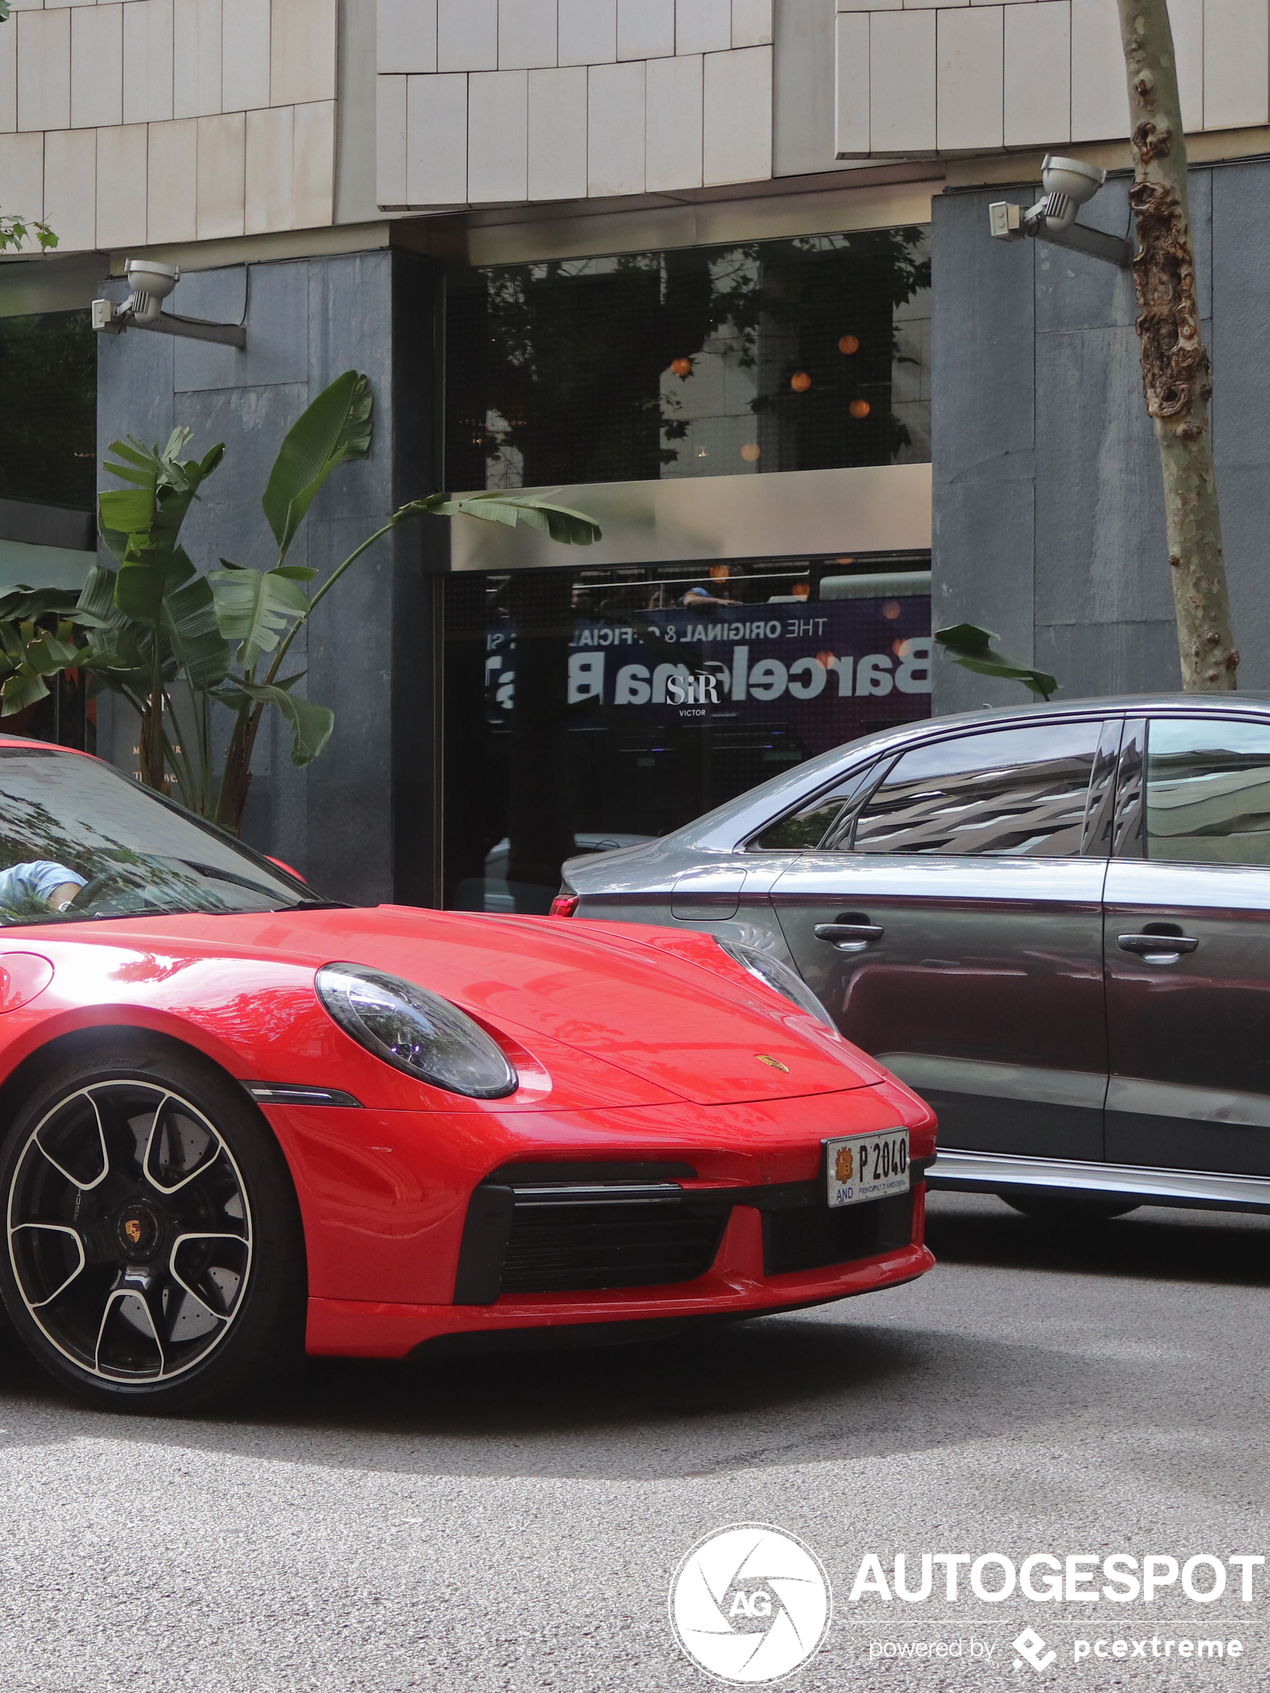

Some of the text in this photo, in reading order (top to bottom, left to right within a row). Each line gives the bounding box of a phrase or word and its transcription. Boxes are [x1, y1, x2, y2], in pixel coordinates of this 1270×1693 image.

[667, 674, 721, 706] SiR
[679, 709, 706, 717] VICTOR
[859, 1137, 907, 1183] P 2040
[836, 1187, 854, 1201] AND
